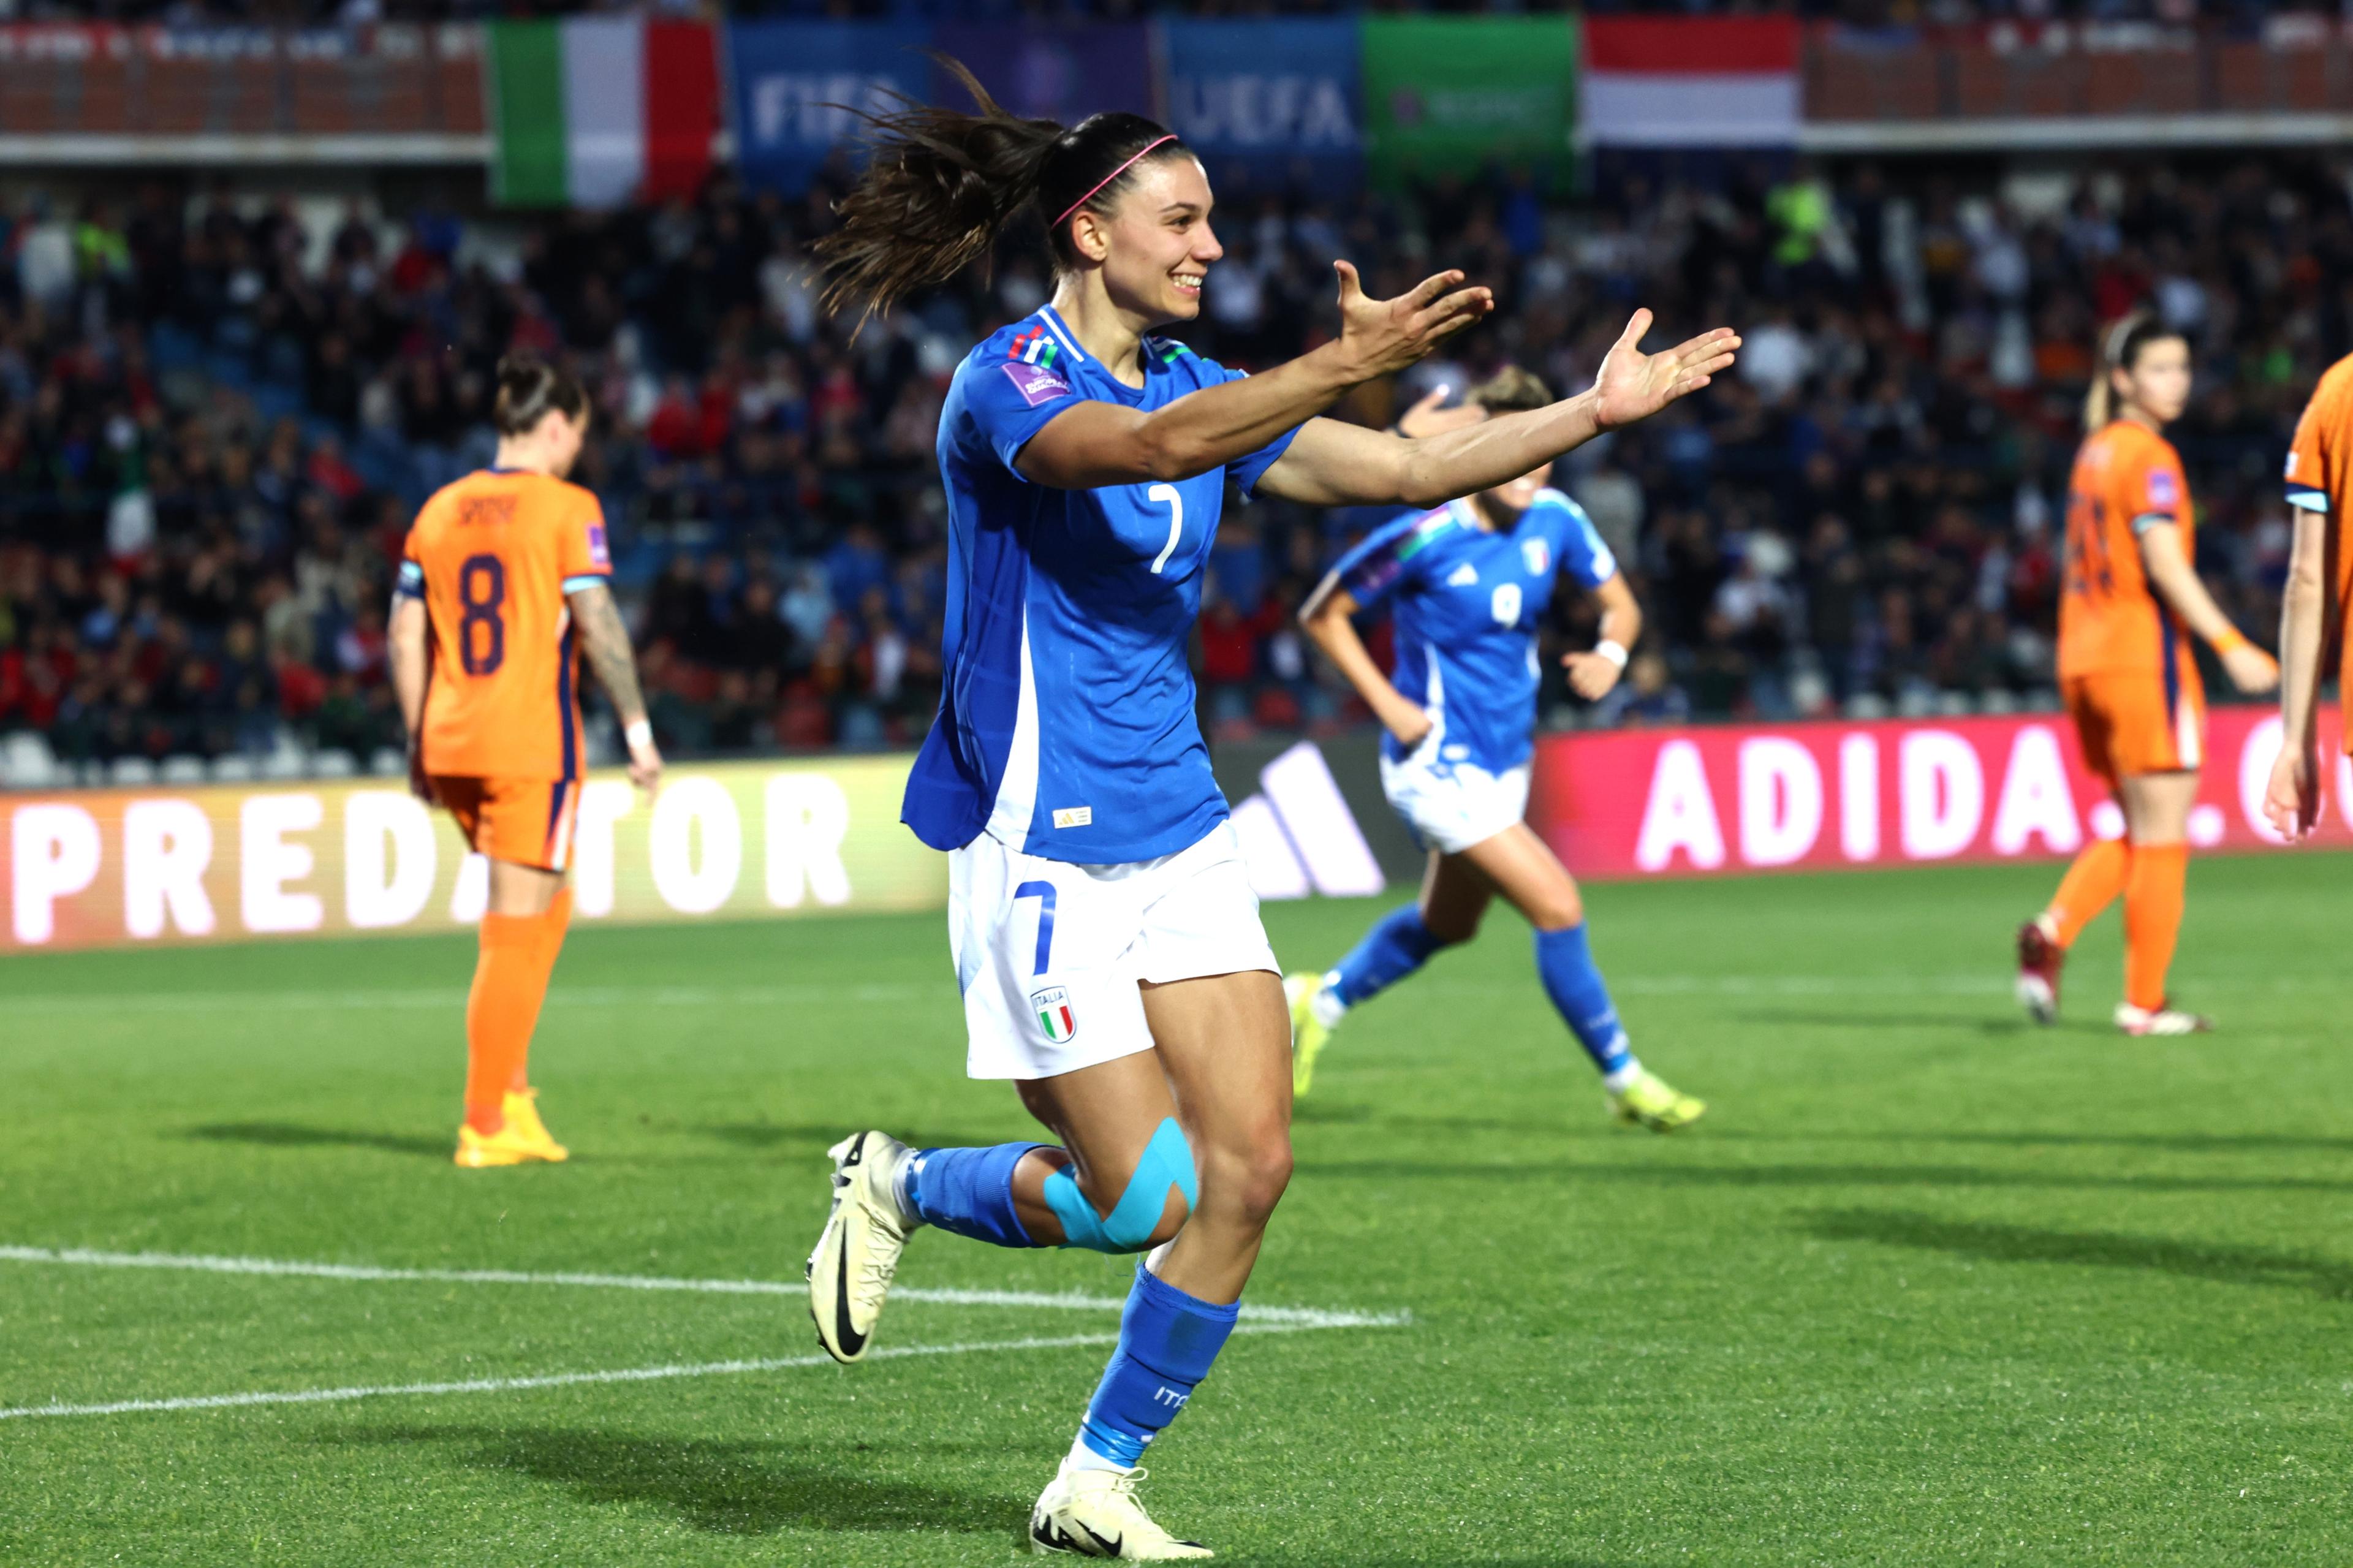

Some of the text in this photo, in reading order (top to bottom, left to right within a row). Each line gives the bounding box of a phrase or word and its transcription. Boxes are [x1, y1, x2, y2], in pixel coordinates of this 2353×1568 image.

[1148, 483, 1183, 574] 7
[460, 554, 505, 678] 8
[12, 772, 852, 945] PREDTOR
[1014, 880, 1057, 977] 7
[1034, 991, 1064, 1007] ITALIA
